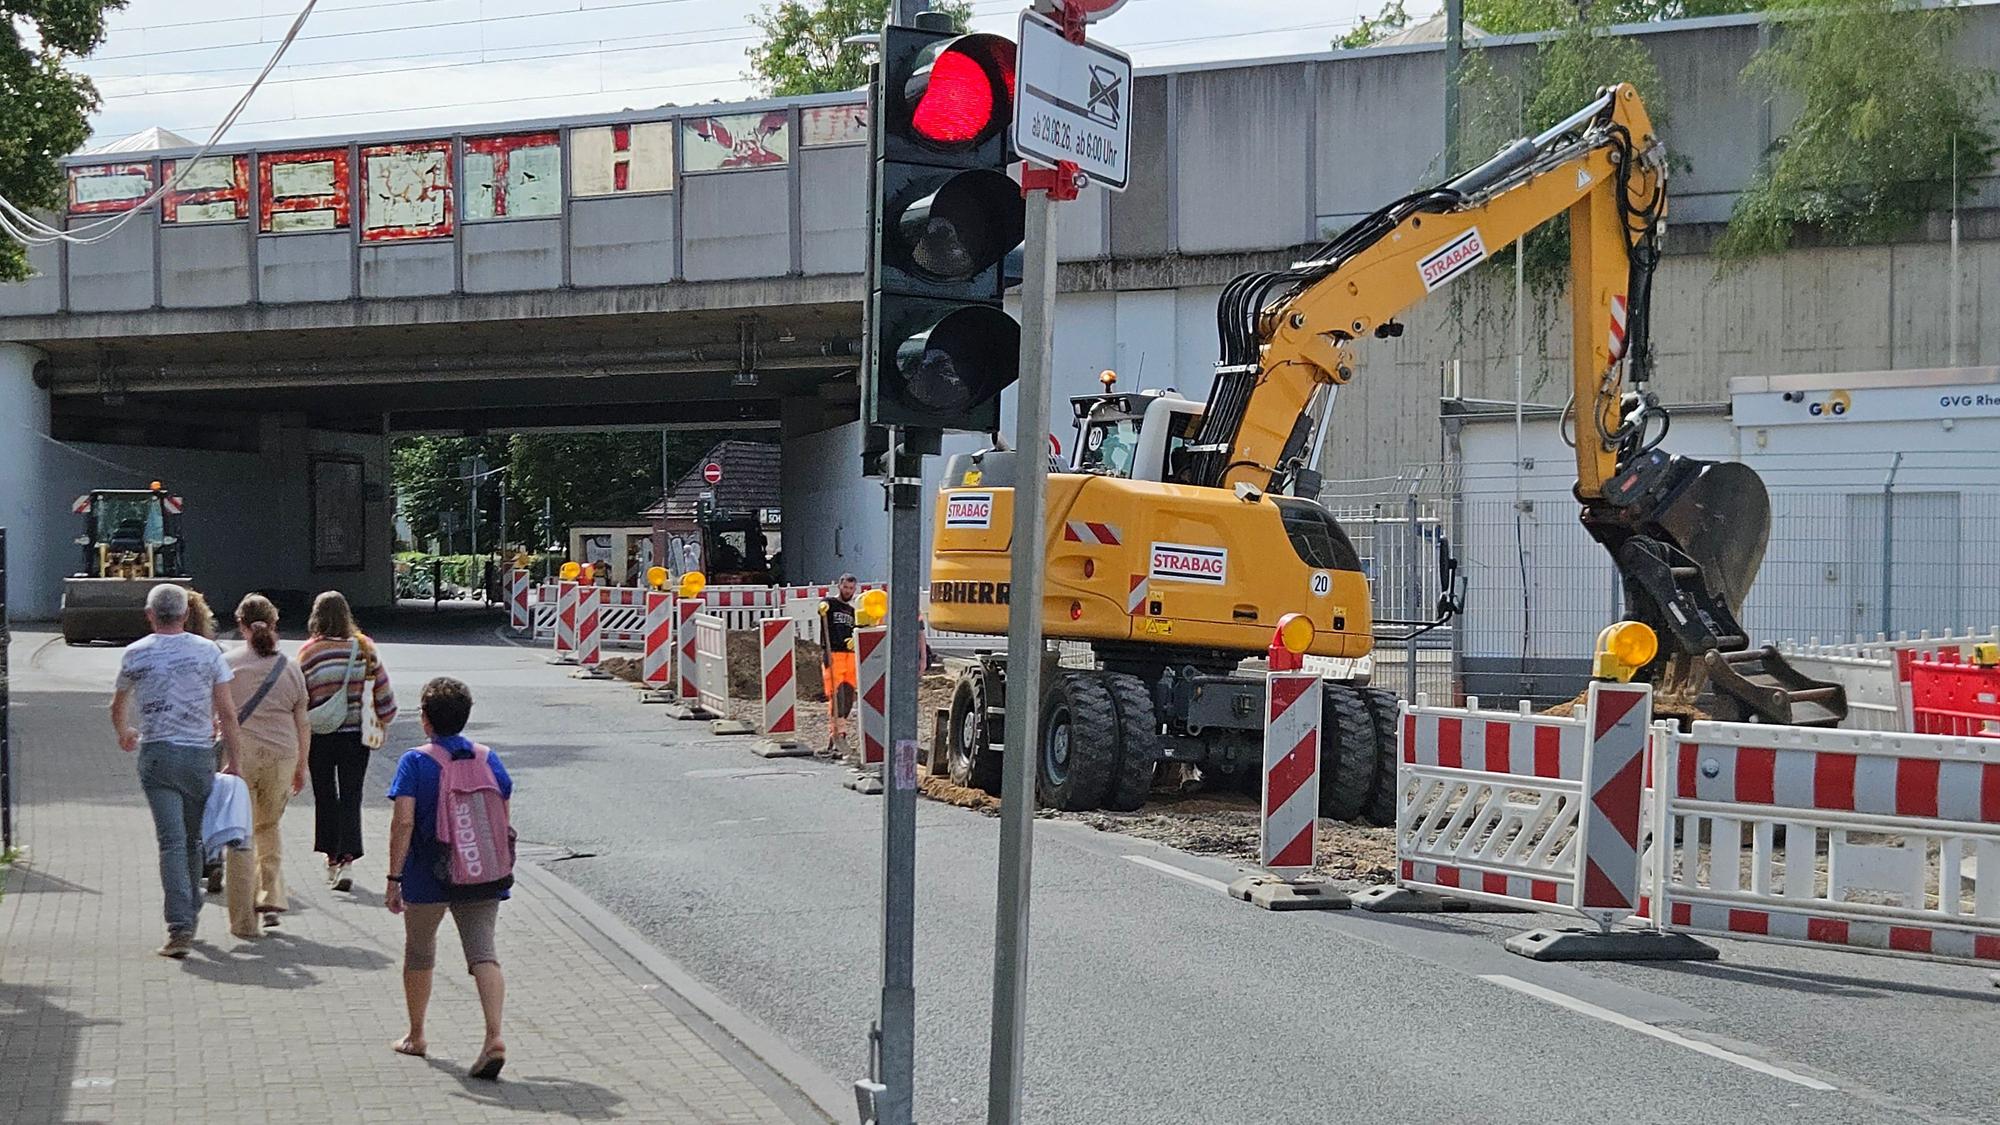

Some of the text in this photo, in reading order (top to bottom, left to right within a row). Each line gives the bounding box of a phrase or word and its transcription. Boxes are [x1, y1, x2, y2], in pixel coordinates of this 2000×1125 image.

[1032, 112, 1041, 138] ab
[1076, 130, 1085, 155] ab
[1103, 138, 1118, 168] Uhr
[1424, 239, 1480, 281] STRABAG
[1809, 402, 1845, 416] GVG
[1940, 395, 1972, 407] GVG
[1090, 430, 1101, 446] 20
[948, 503, 989, 518] STRABAG
[1153, 553, 1223, 574] STRABAG
[1314, 575, 1328, 592] 20
[457, 803, 483, 877] adidas
